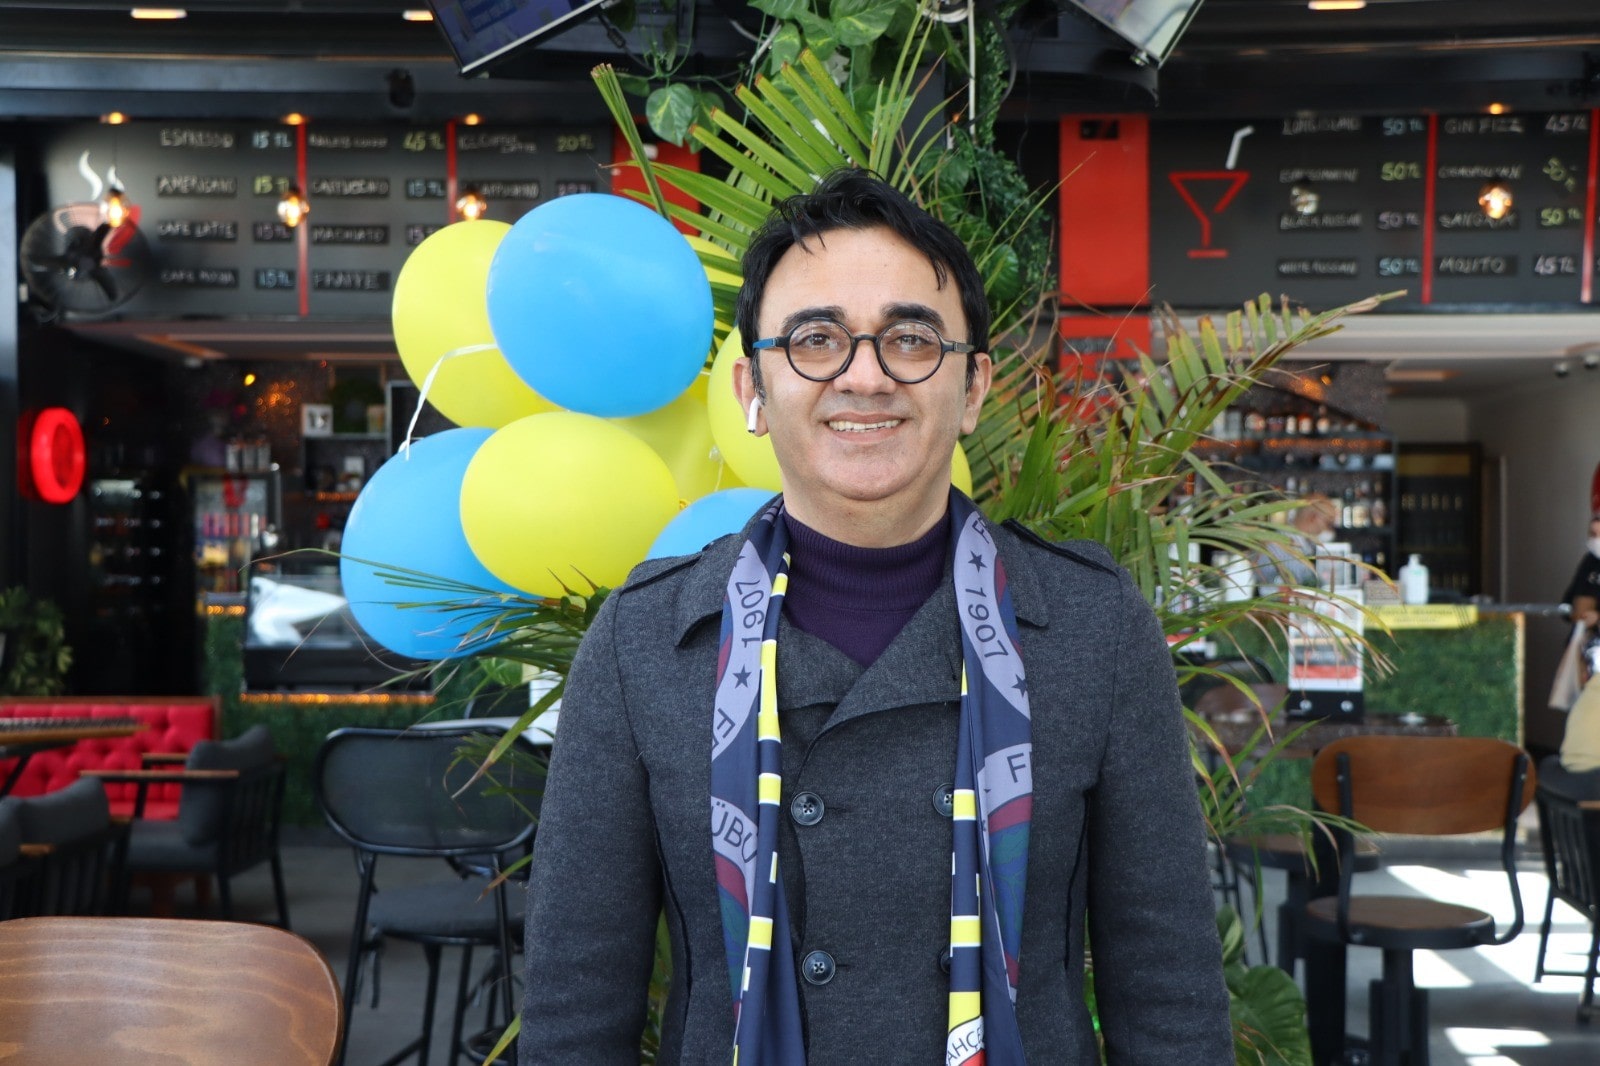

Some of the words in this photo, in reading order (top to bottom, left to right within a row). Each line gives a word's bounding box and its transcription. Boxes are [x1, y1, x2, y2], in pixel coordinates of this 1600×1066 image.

[1382, 118, 1406, 136] 50
[1381, 162, 1407, 181] 50
[1378, 211, 1404, 230] 50
[1540, 207, 1565, 227] 50
[1379, 257, 1404, 276] 50
[1438, 255, 1507, 274] MOJITO
[1534, 255, 1558, 275] 45
[735, 579, 765, 648] 1907
[965, 586, 1009, 658] 1907
